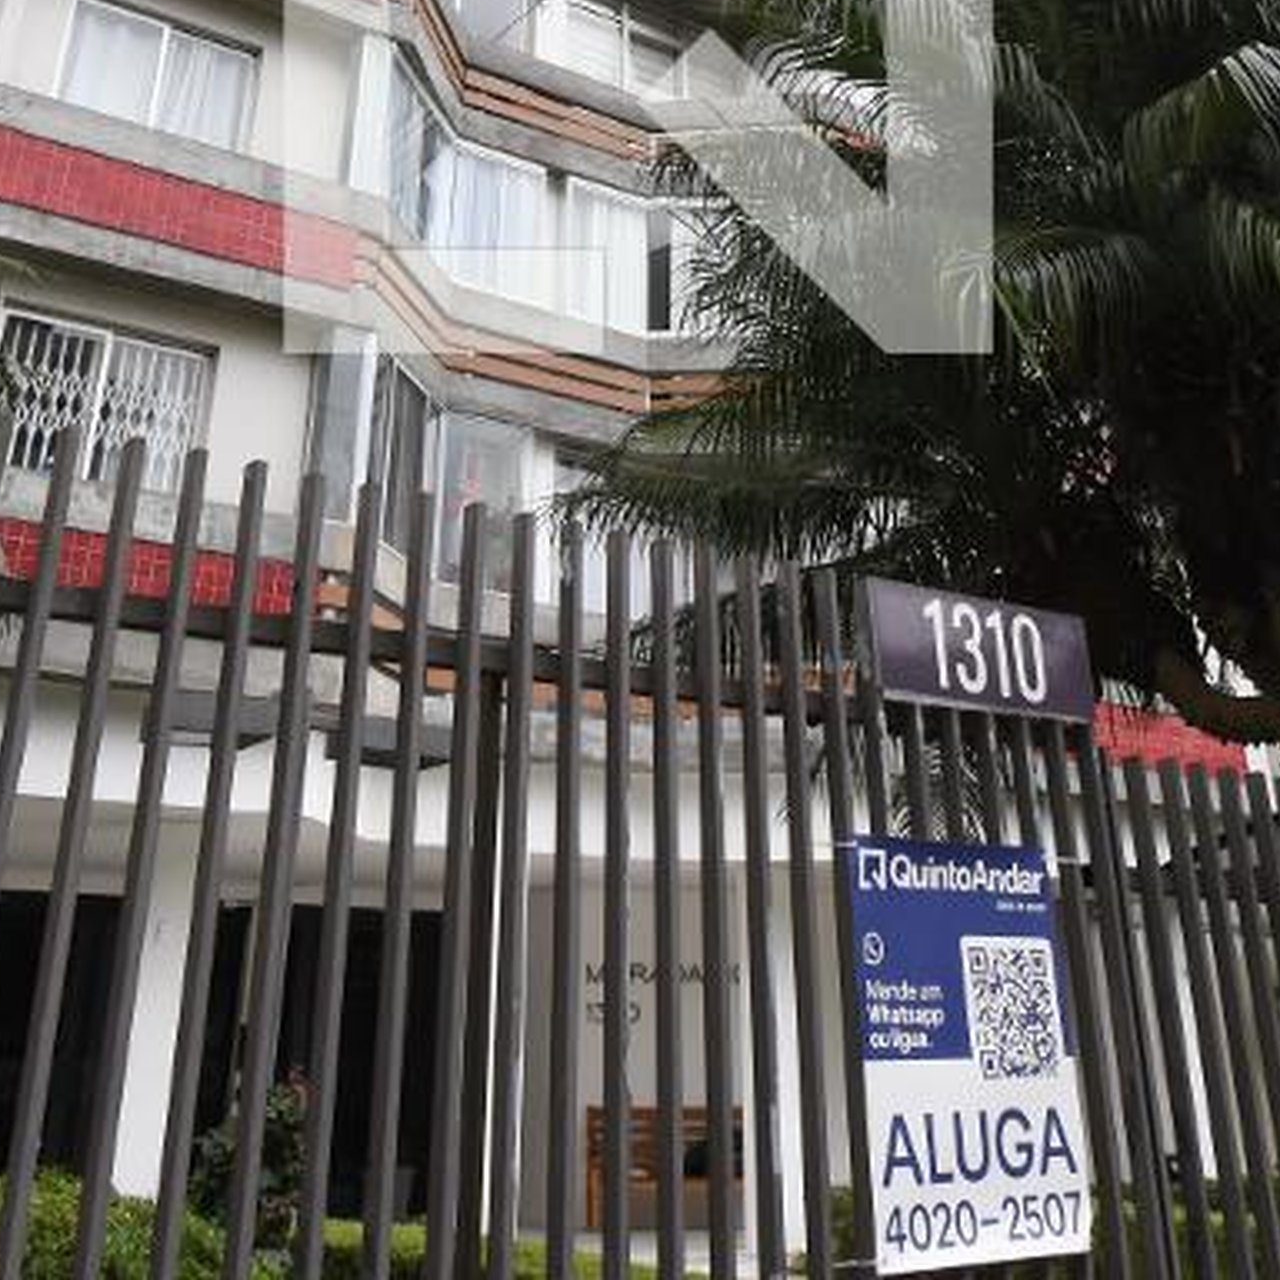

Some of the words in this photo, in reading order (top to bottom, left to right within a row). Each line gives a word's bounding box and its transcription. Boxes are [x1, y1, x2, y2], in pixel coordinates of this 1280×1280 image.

[923, 598, 1047, 704] 1310
[889, 853, 1045, 895] QuintoAndar
[882, 1106, 1079, 1188] ALUGA
[885, 1190, 1081, 1253] 4020-2507
